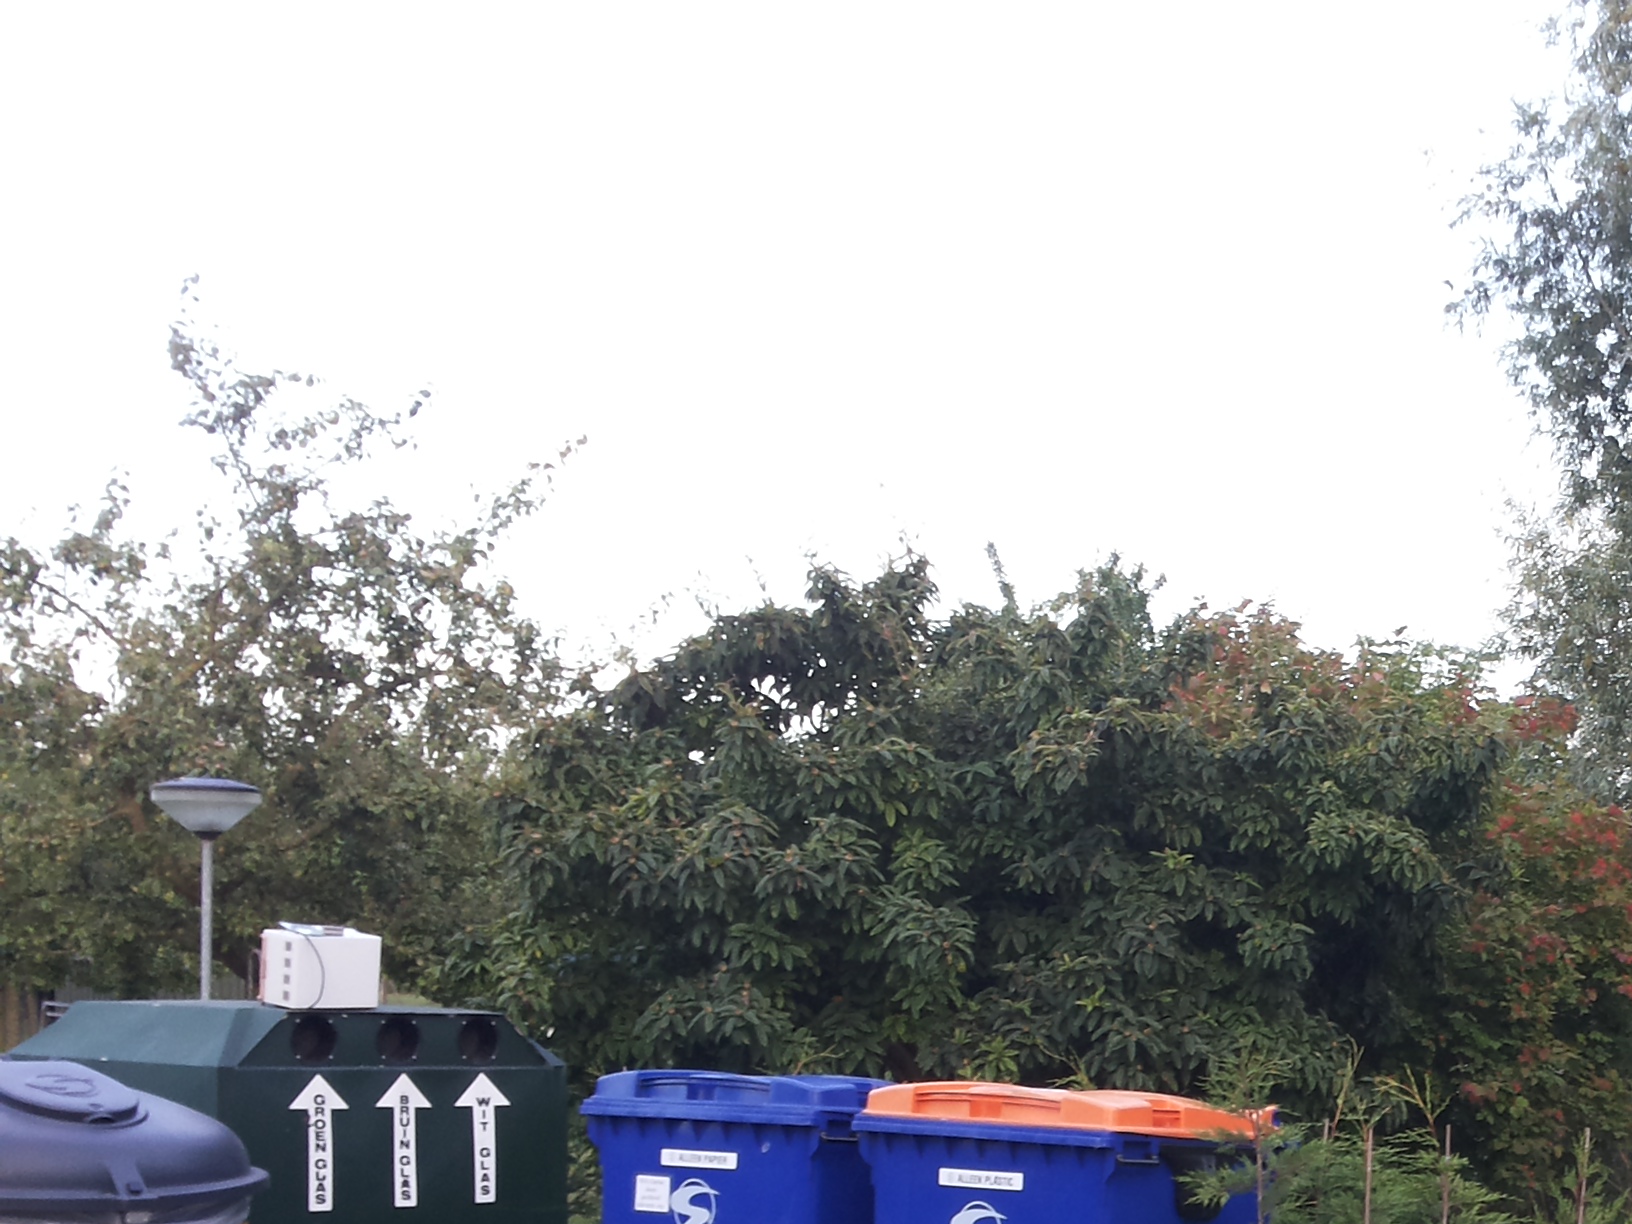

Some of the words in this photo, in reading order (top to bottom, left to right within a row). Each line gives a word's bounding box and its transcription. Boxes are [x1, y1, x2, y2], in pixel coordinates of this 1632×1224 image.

[313, 1094, 326, 1153] GROEN
[400, 1095, 411, 1150] BRUIN
[475, 1097, 491, 1132] WIT
[314, 1158, 326, 1205] GLAS
[400, 1155, 411, 1201] GLAS
[479, 1147, 491, 1196] GLAS
